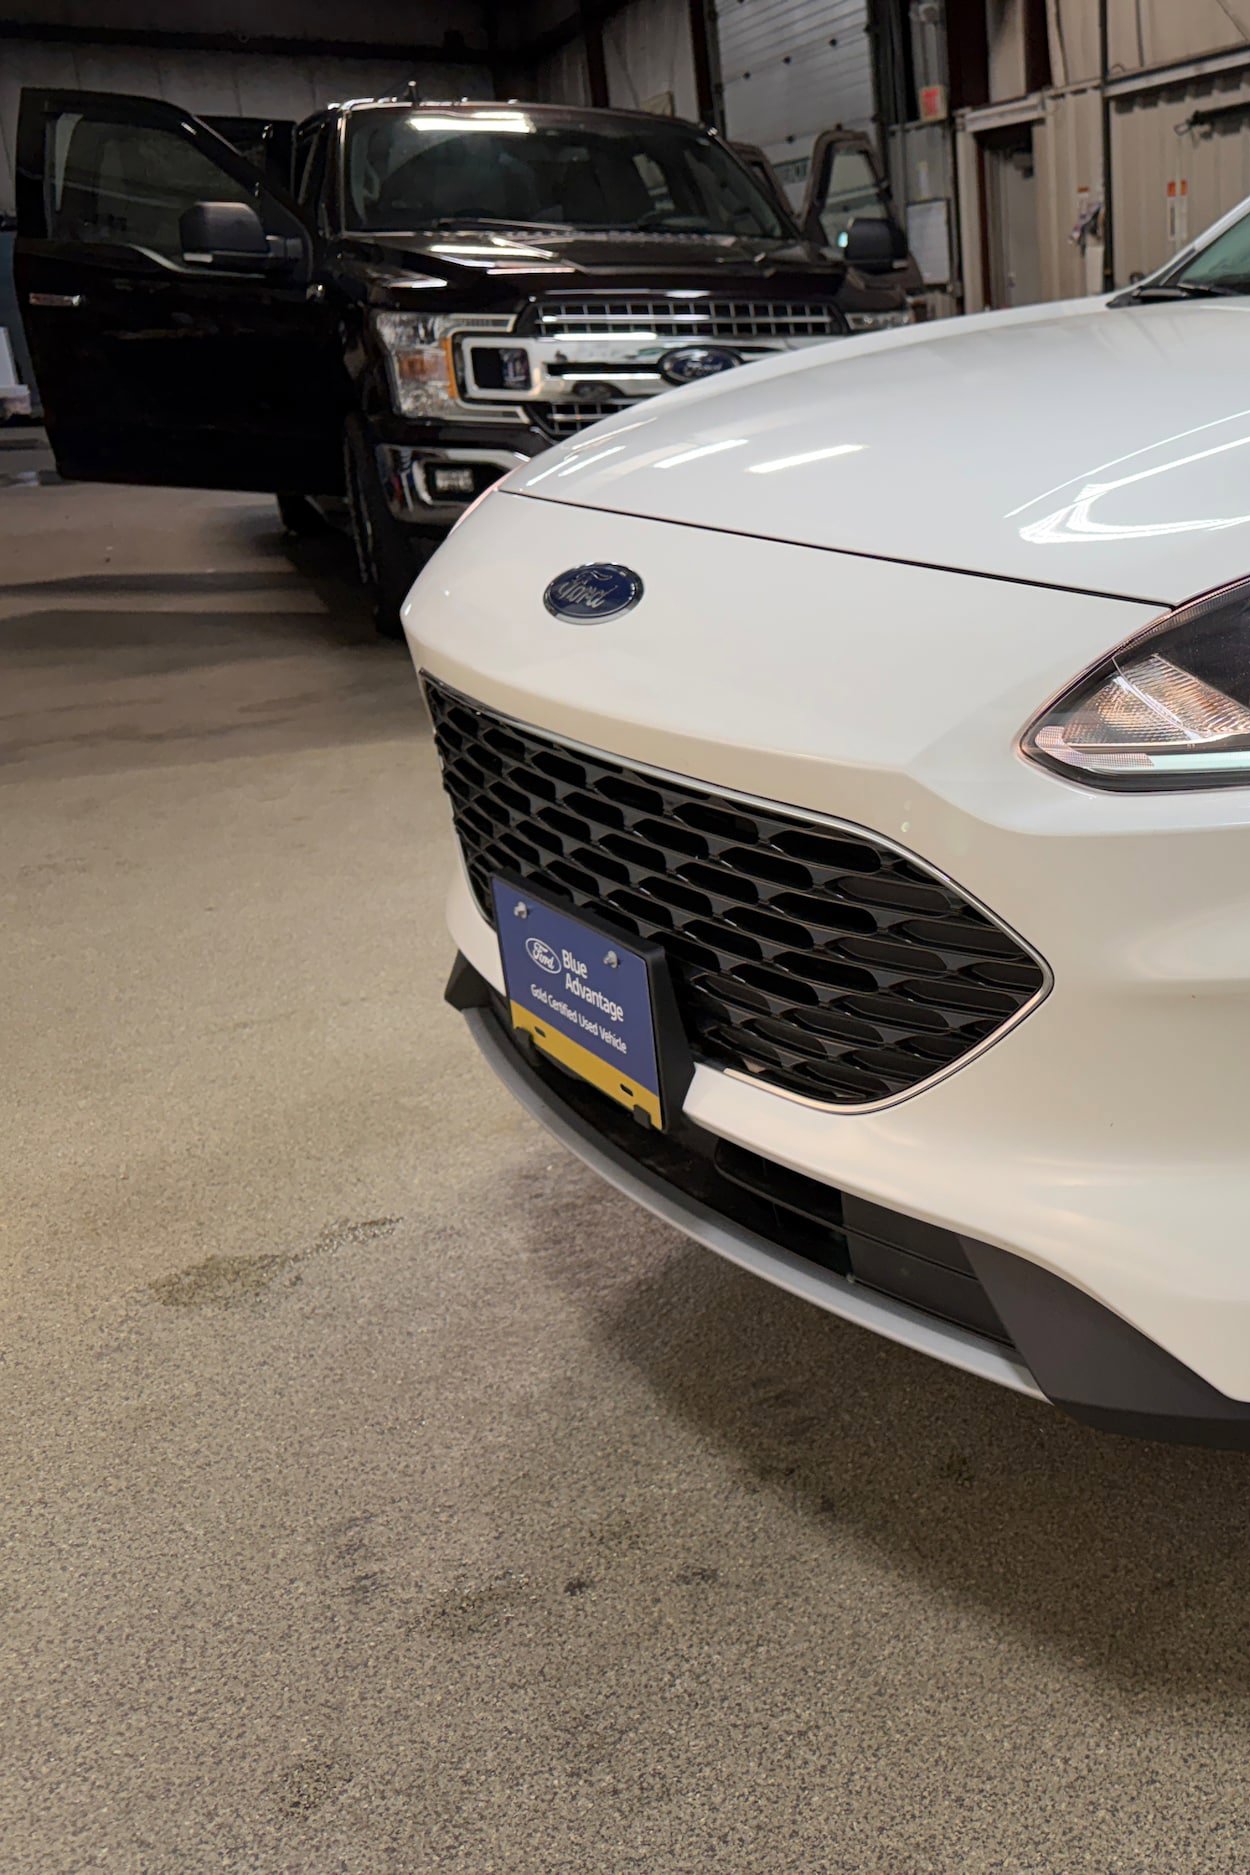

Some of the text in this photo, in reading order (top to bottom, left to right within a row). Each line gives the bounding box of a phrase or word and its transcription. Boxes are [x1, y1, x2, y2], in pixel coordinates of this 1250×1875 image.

[558, 570, 618, 609] Ford
[532, 942, 555, 970] Ford
[561, 949, 588, 979] Blue
[565, 973, 624, 1022] Advantage
[530, 984, 627, 1054] Gold Certified Used Vehicle
